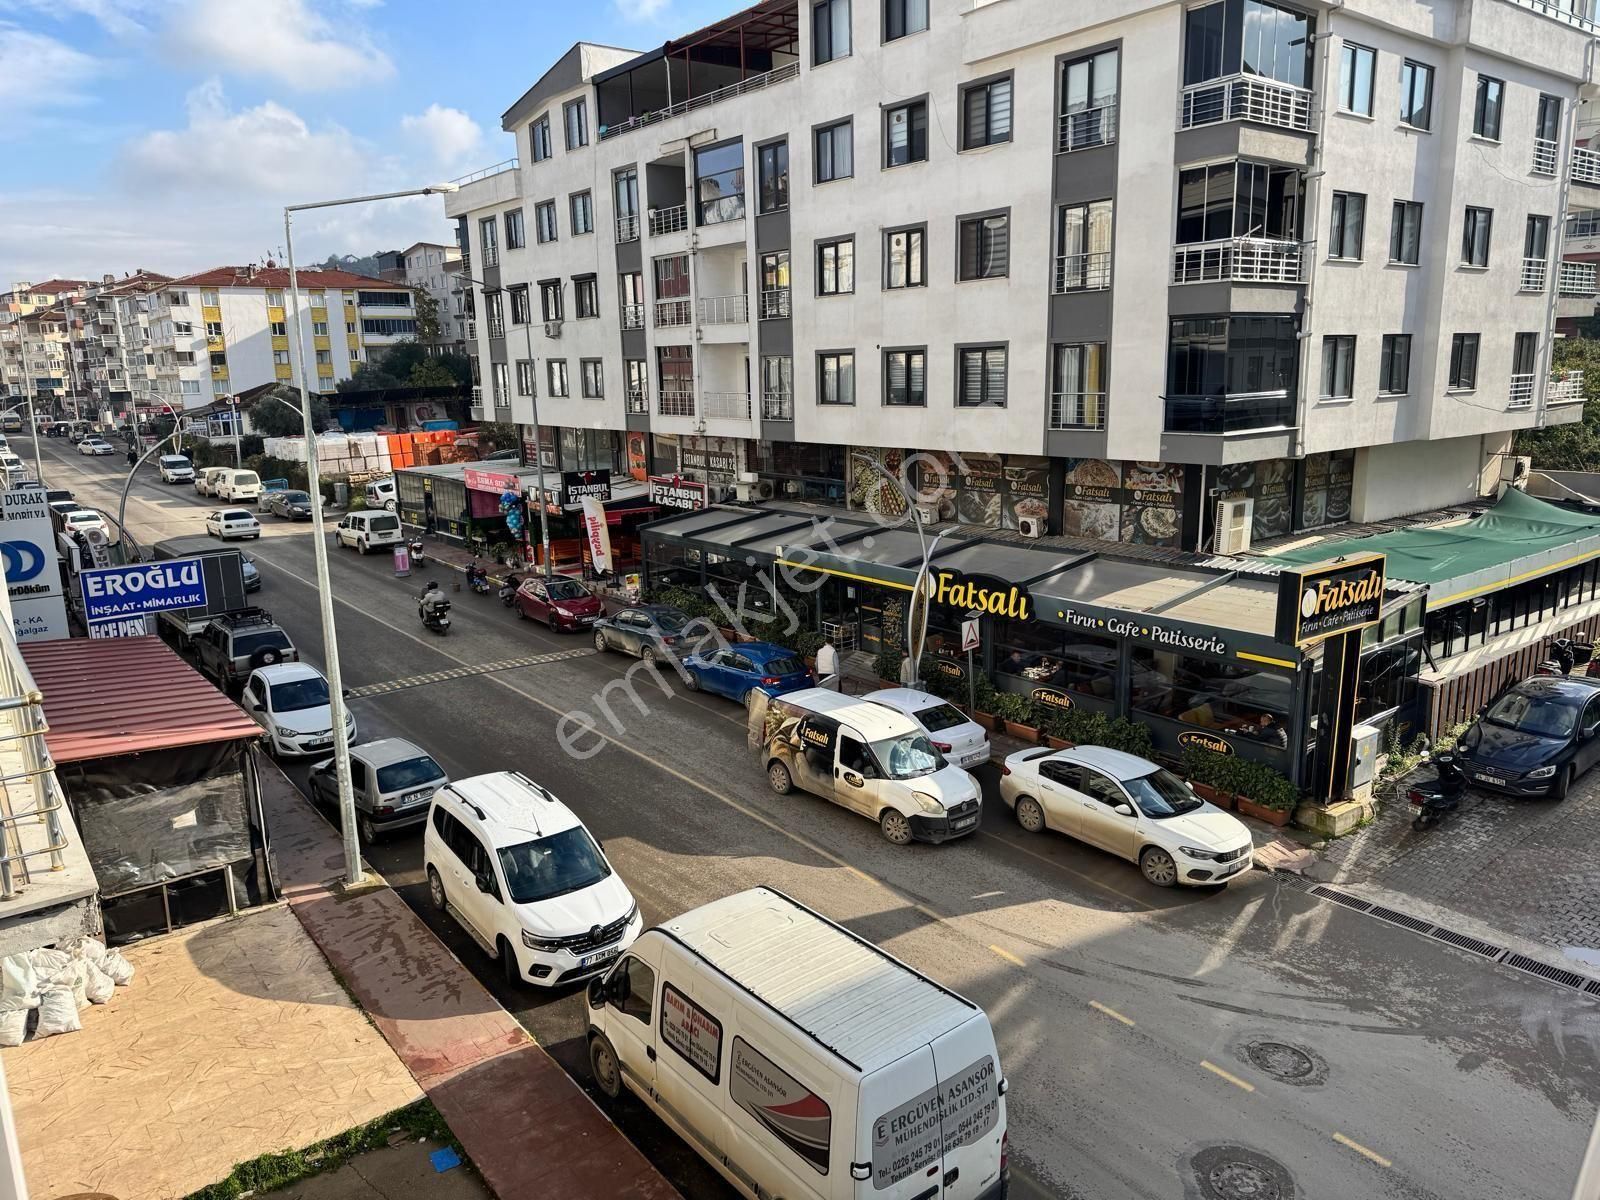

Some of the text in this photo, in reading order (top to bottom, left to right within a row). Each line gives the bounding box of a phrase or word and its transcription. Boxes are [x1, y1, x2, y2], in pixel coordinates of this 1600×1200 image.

[5, 492, 44, 506] DURAK
[568, 483, 610, 496] İSTANBUL
[570, 493, 602, 504] KAABI
[651, 482, 703, 501] İSTANBUL
[655, 495, 692, 510] KASABI
[86, 565, 199, 597] EROĞLU
[937, 572, 1029, 620] Fatsalı
[1314, 570, 1381, 615] Fatsalı
[91, 602, 136, 616] İNŞAAT
[143, 594, 201, 609] MİMARLIK
[29, 616, 43, 624] KA
[1323, 615, 1338, 628] Cafe
[1342, 606, 1374, 621] Patisserie
[1066, 609, 1225, 654] Fırın Cafe Patisserie
[891, 1093, 945, 1134] ERGÜVEN
[948, 1062, 994, 1102] ASANSÖR
[892, 1155, 910, 1172] 0226
[910, 1147, 923, 1162] 245
[924, 1142, 932, 1154] 79
[891, 1167, 913, 1184] Teknik
